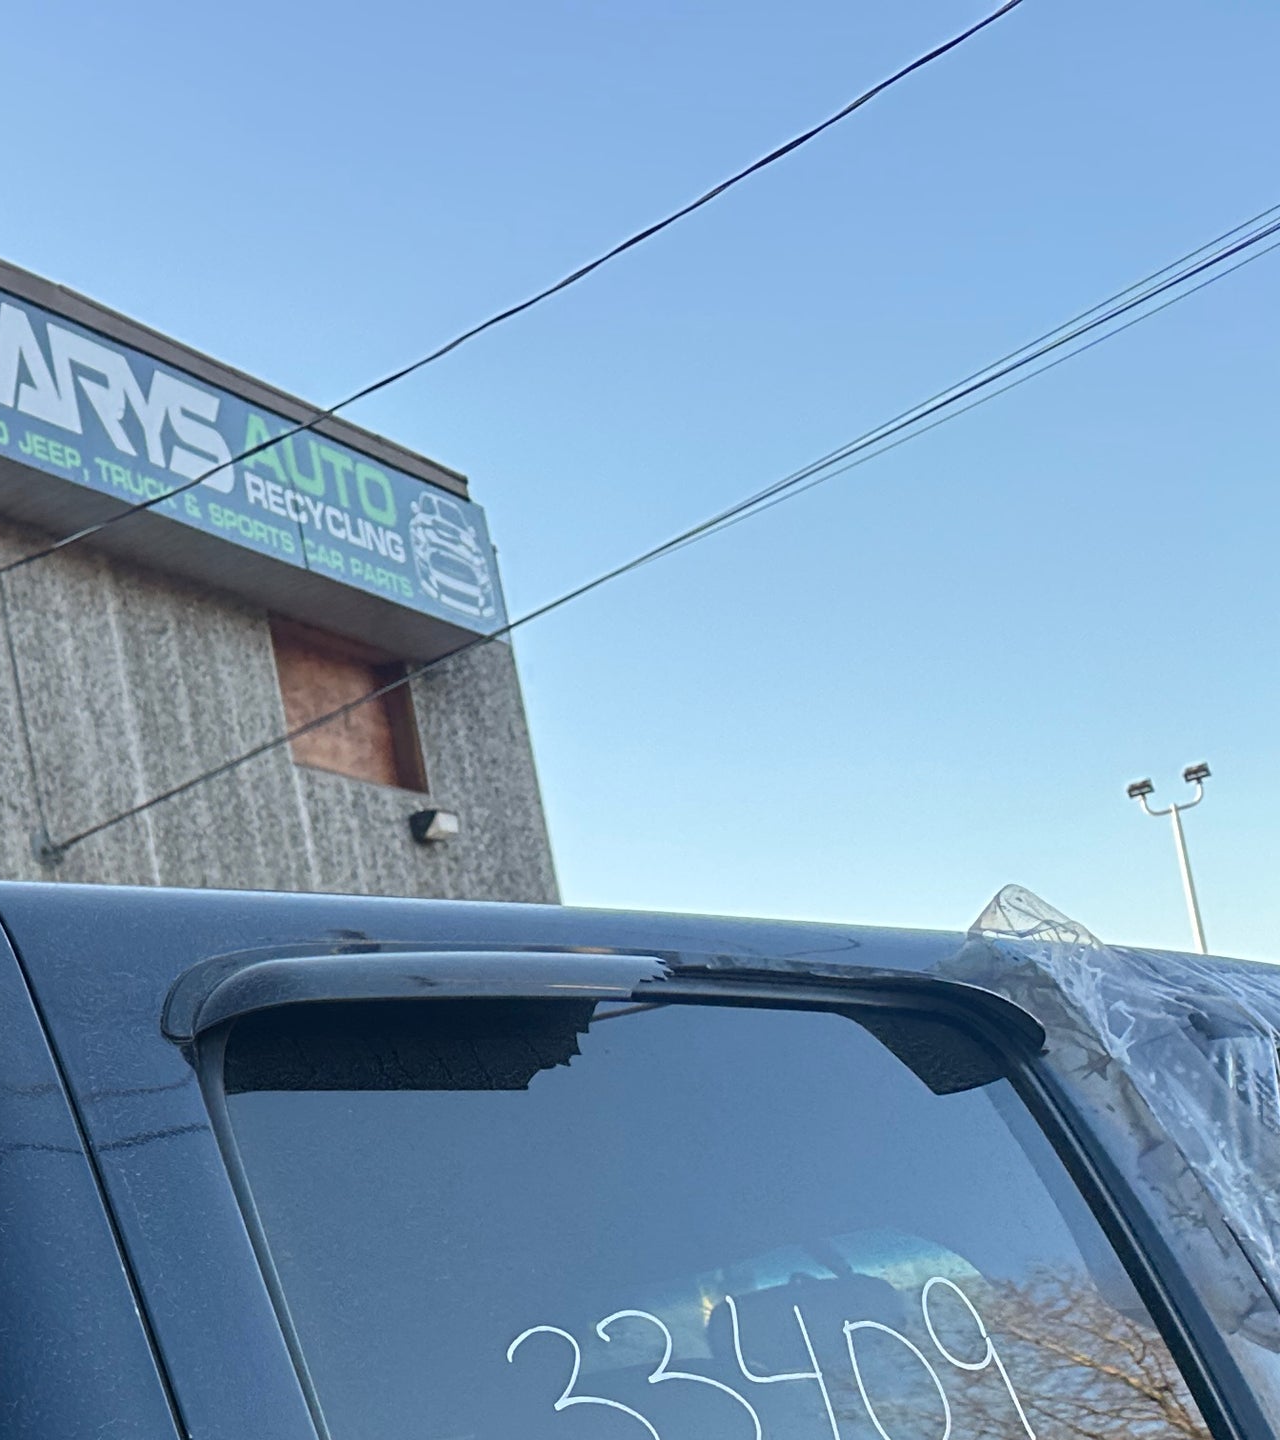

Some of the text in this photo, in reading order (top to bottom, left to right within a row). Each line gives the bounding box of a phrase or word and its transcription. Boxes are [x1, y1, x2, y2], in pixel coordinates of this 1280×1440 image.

[18, 430, 89, 481] JEEP,
[94, 457, 177, 509] TRUCK
[184, 492, 203, 519] &
[208, 502, 295, 554] SPORTS
[303, 537, 345, 572] CAR
[351, 556, 414, 598] PARTS
[243, 412, 397, 527] AUTO
[244, 471, 406, 563] RECYCLING
